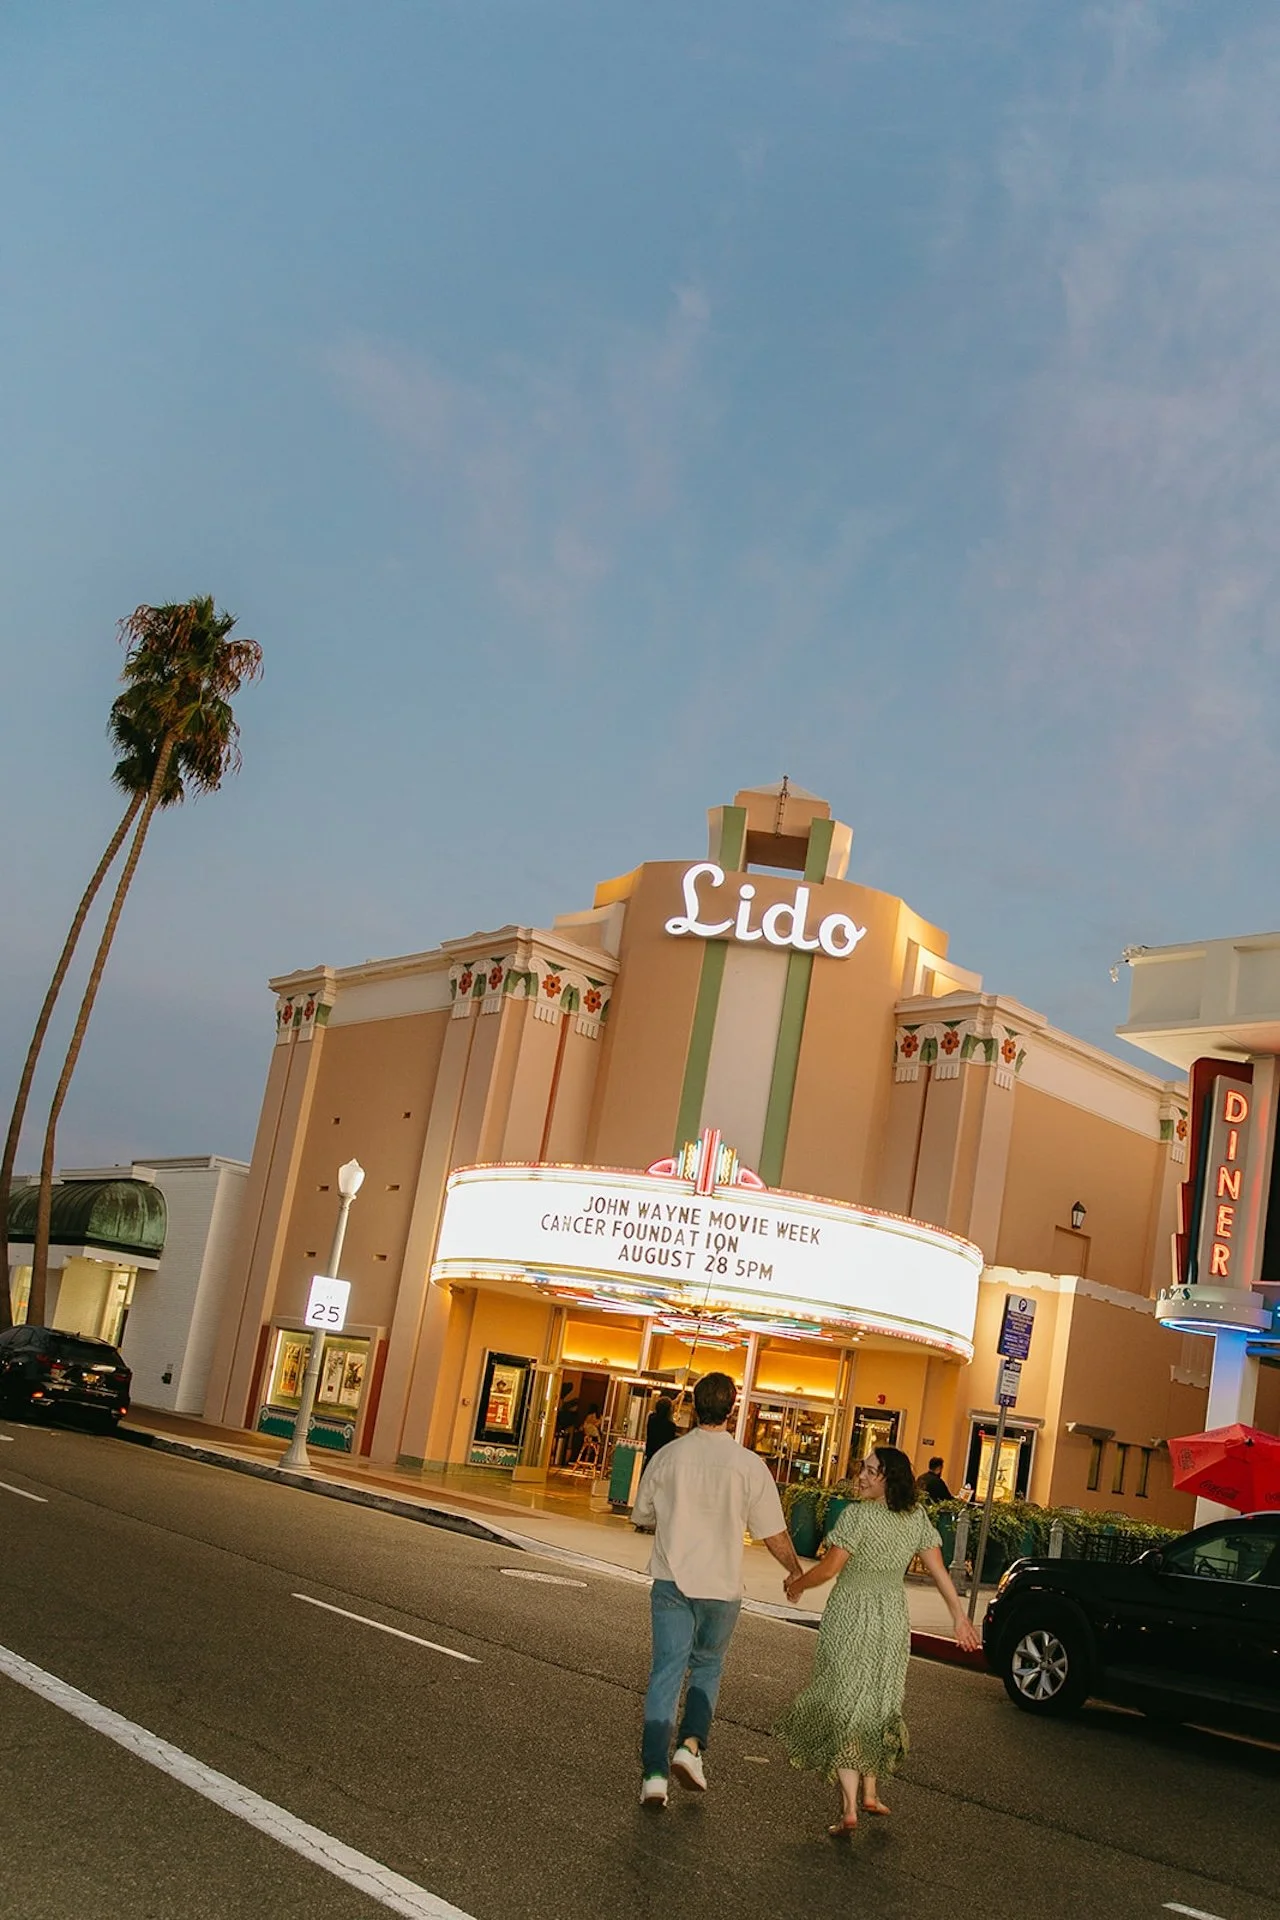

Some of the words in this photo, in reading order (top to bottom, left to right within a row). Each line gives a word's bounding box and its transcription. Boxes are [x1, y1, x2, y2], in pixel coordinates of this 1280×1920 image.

[665, 863, 867, 957] Lido
[1209, 1089, 1249, 1277] DINER
[541, 1213, 607, 1236] CANCER
[583, 1196, 630, 1217] JOHN
[637, 1200, 701, 1226] WAYNE
[708, 1211, 770, 1236] MOVIE
[776, 1220, 822, 1245] WEEK
[617, 1244, 696, 1269] AUGUST
[704, 1255, 728, 1274] 28
[735, 1258, 774, 1281] 5PM
[311, 1303, 340, 1323] 25
